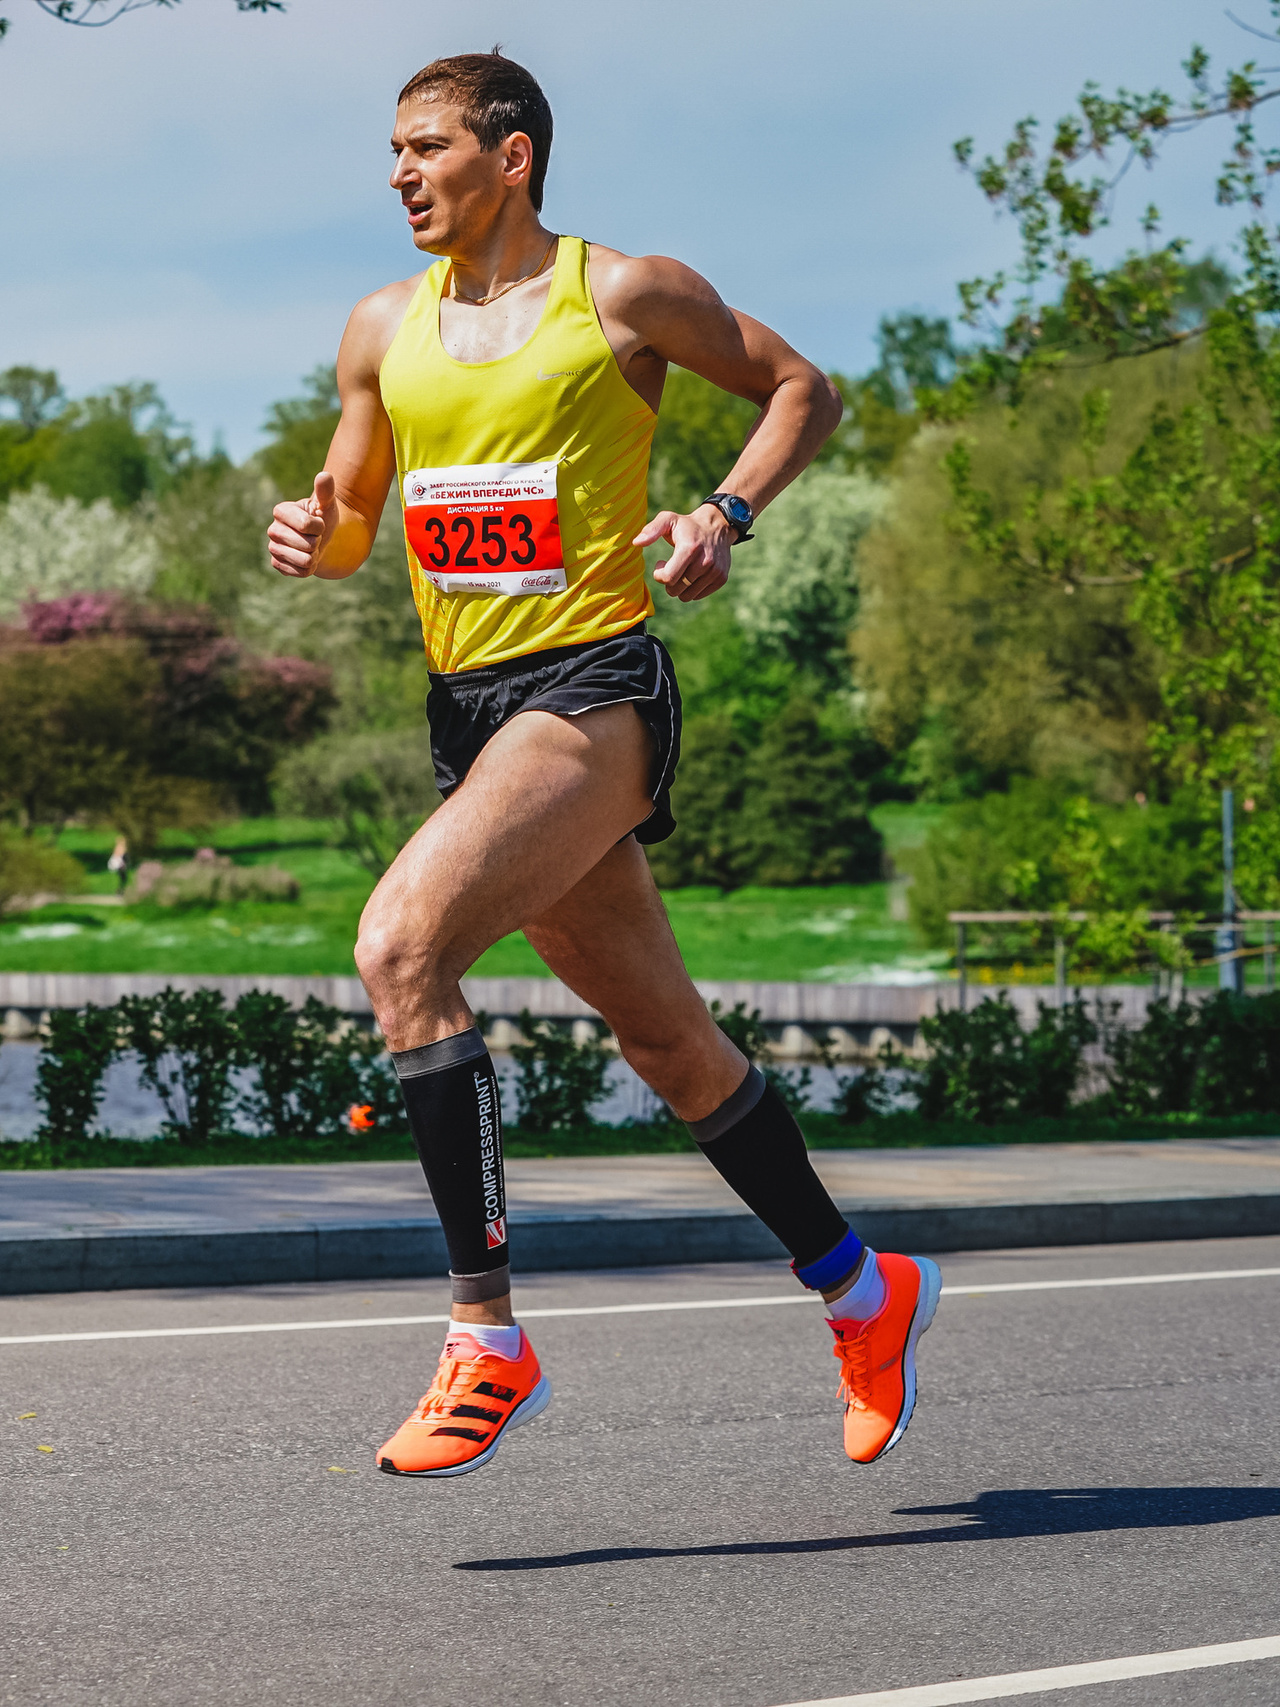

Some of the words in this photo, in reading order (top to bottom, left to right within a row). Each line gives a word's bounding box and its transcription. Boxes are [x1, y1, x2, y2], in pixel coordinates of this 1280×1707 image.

[430, 489, 471, 499] «БЕЖИМ
[473, 487, 521, 498] ВПЕРЕДИ
[523, 486, 544, 495] ЧС»
[447, 505, 489, 514] ДИСТАНЦИЯ
[425, 514, 537, 567] 3253
